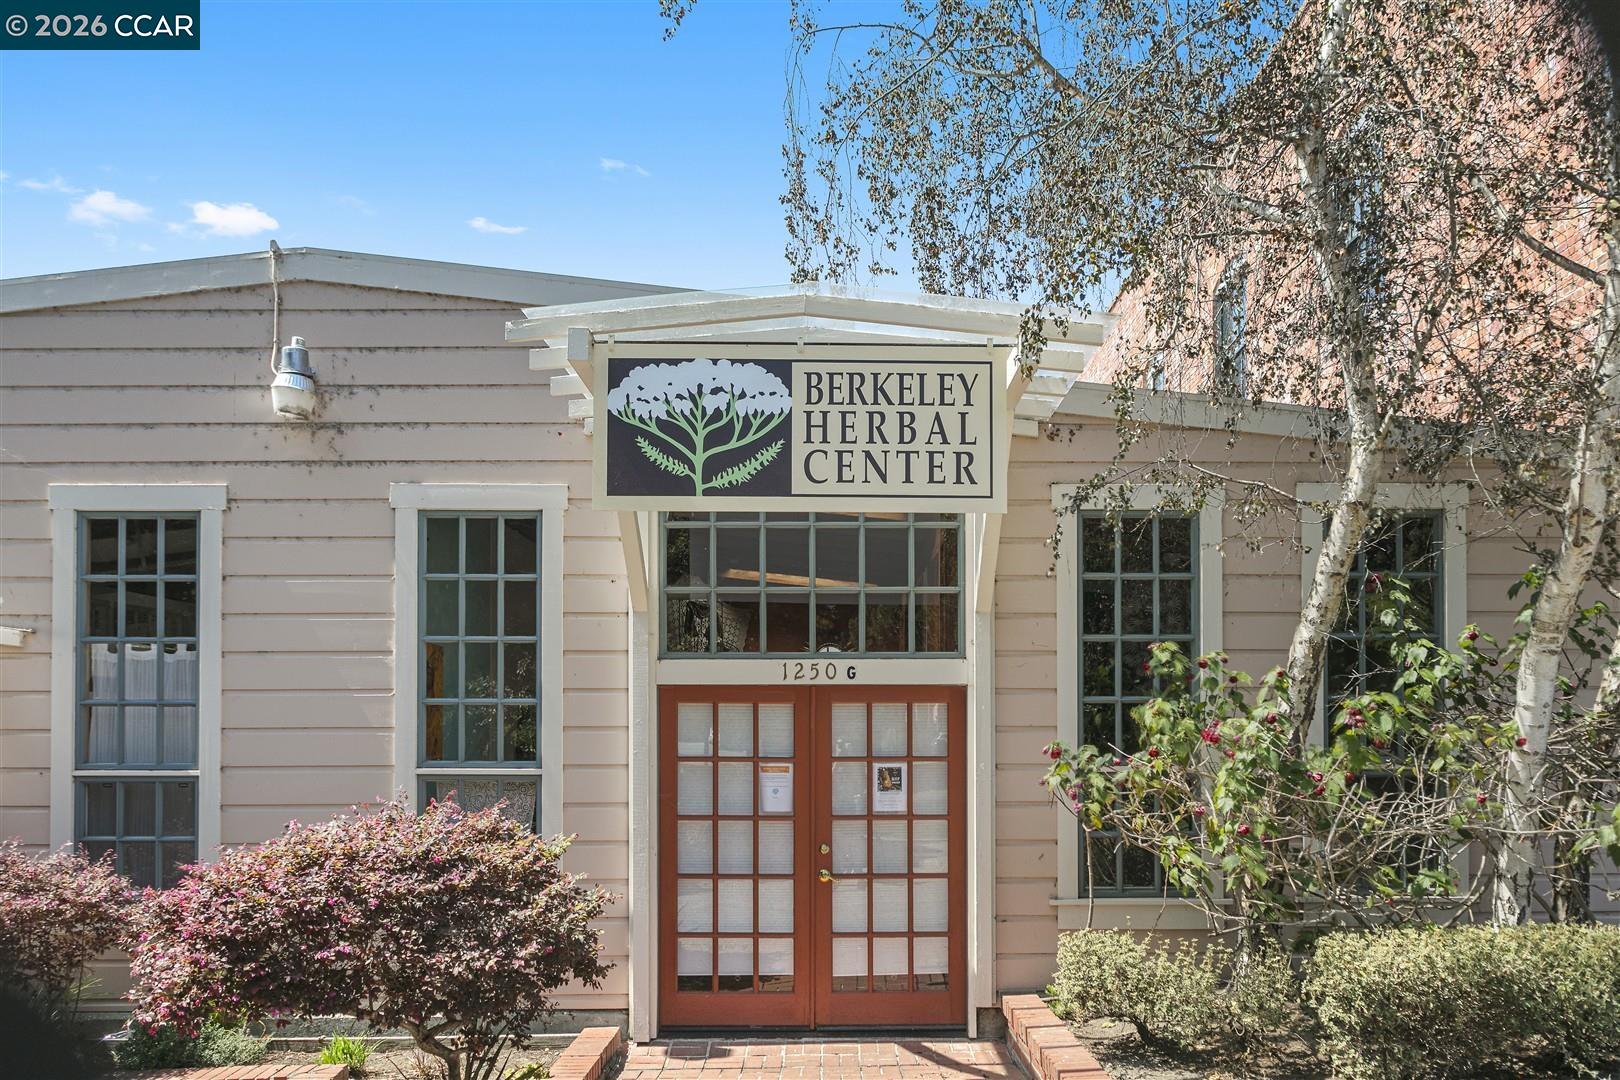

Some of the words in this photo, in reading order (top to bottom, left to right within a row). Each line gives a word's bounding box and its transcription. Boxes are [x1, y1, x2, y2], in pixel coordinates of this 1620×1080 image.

[803, 371, 979, 407] BERKELEY
[803, 410, 977, 446] HERBAL
[803, 448, 978, 486] CENTER
[782, 662, 837, 681] 1250
[847, 665, 857, 680] G
